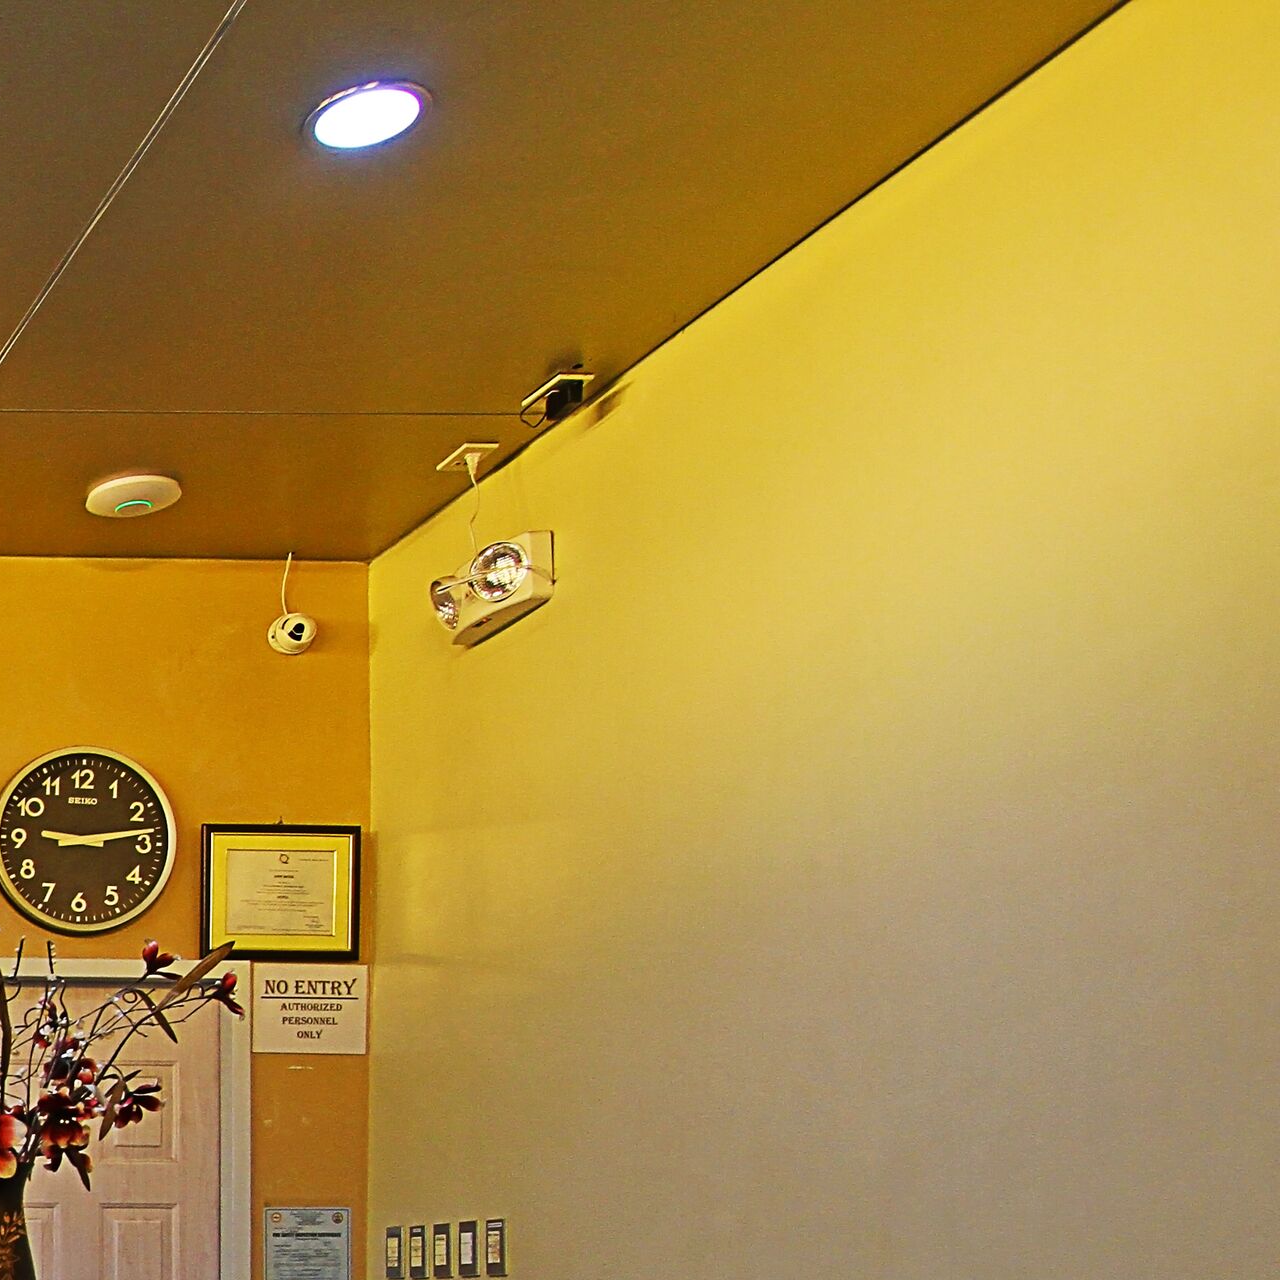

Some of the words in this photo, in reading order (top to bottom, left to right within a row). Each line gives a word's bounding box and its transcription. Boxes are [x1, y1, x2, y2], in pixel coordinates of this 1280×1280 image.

[42, 777, 60, 796] 11
[71, 769, 94, 789] 12
[109, 779, 119, 798] 1
[16, 797, 45, 817] 10
[68, 797, 97, 805] SEIKO
[129, 801, 144, 822] 2
[11, 828, 27, 849] 9
[135, 834, 152, 854] 3
[20, 859, 36, 879] 8
[126, 865, 142, 885] 4
[42, 882, 56, 902] 7
[71, 892, 87, 912] 6
[104, 886, 119, 906] 5
[265, 979, 288, 995] NO
[295, 978, 357, 996] ENTRY
[280, 1003, 343, 1012] AUTHORIZED
[282, 1016, 338, 1026] PERSONNEL
[297, 1030, 323, 1039] ONLY
